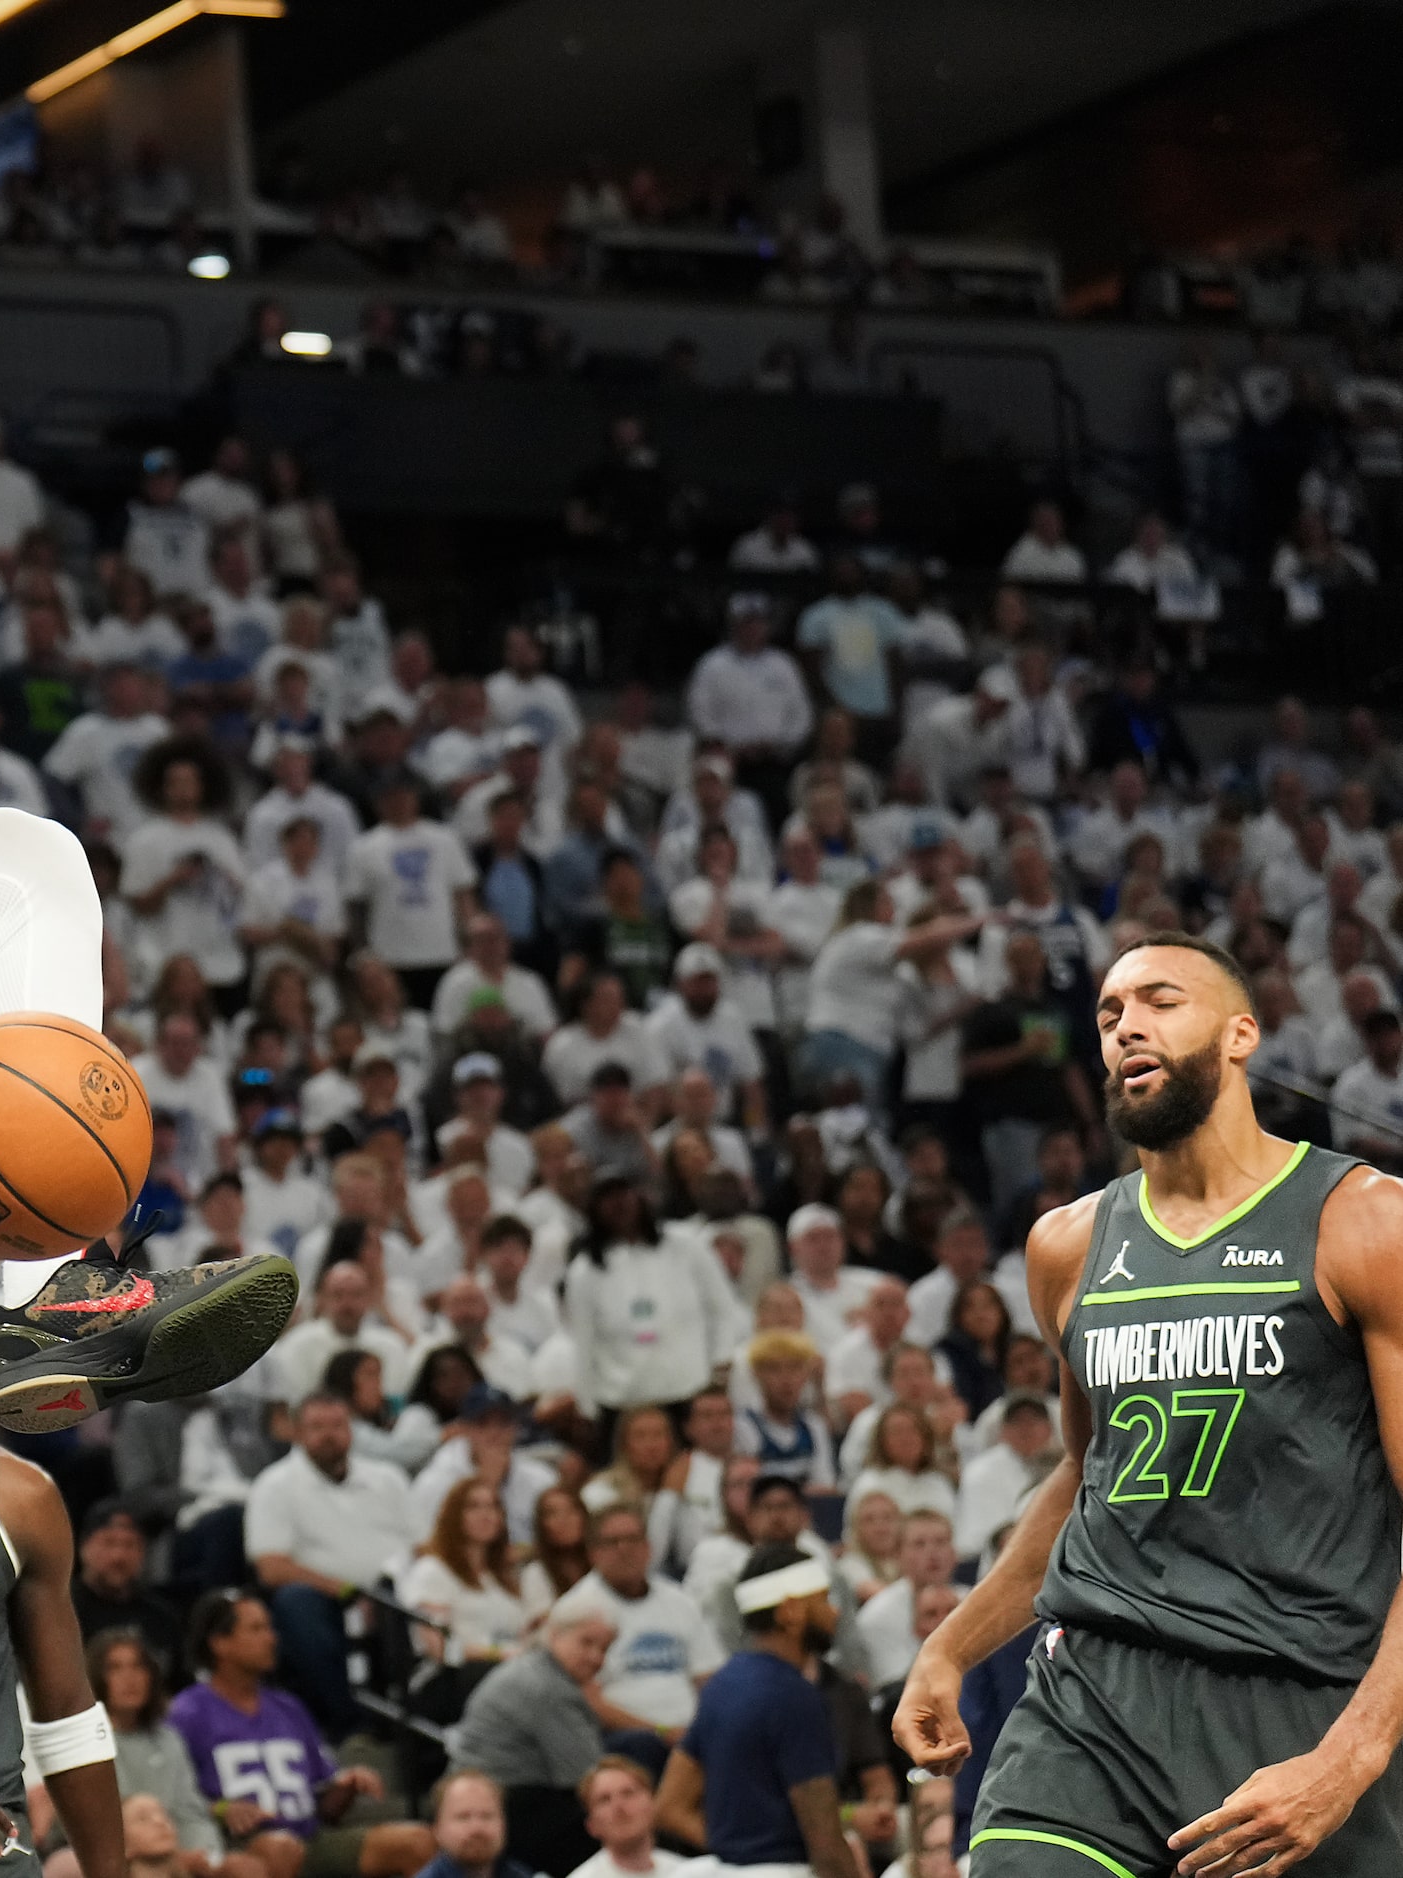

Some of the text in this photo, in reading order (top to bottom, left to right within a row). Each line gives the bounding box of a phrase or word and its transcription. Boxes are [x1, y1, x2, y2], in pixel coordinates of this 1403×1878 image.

[1084, 1315, 1284, 1394] TIMBERWOLVES
[1108, 1388, 1245, 1504] 27
[212, 1739, 315, 1820] 55
